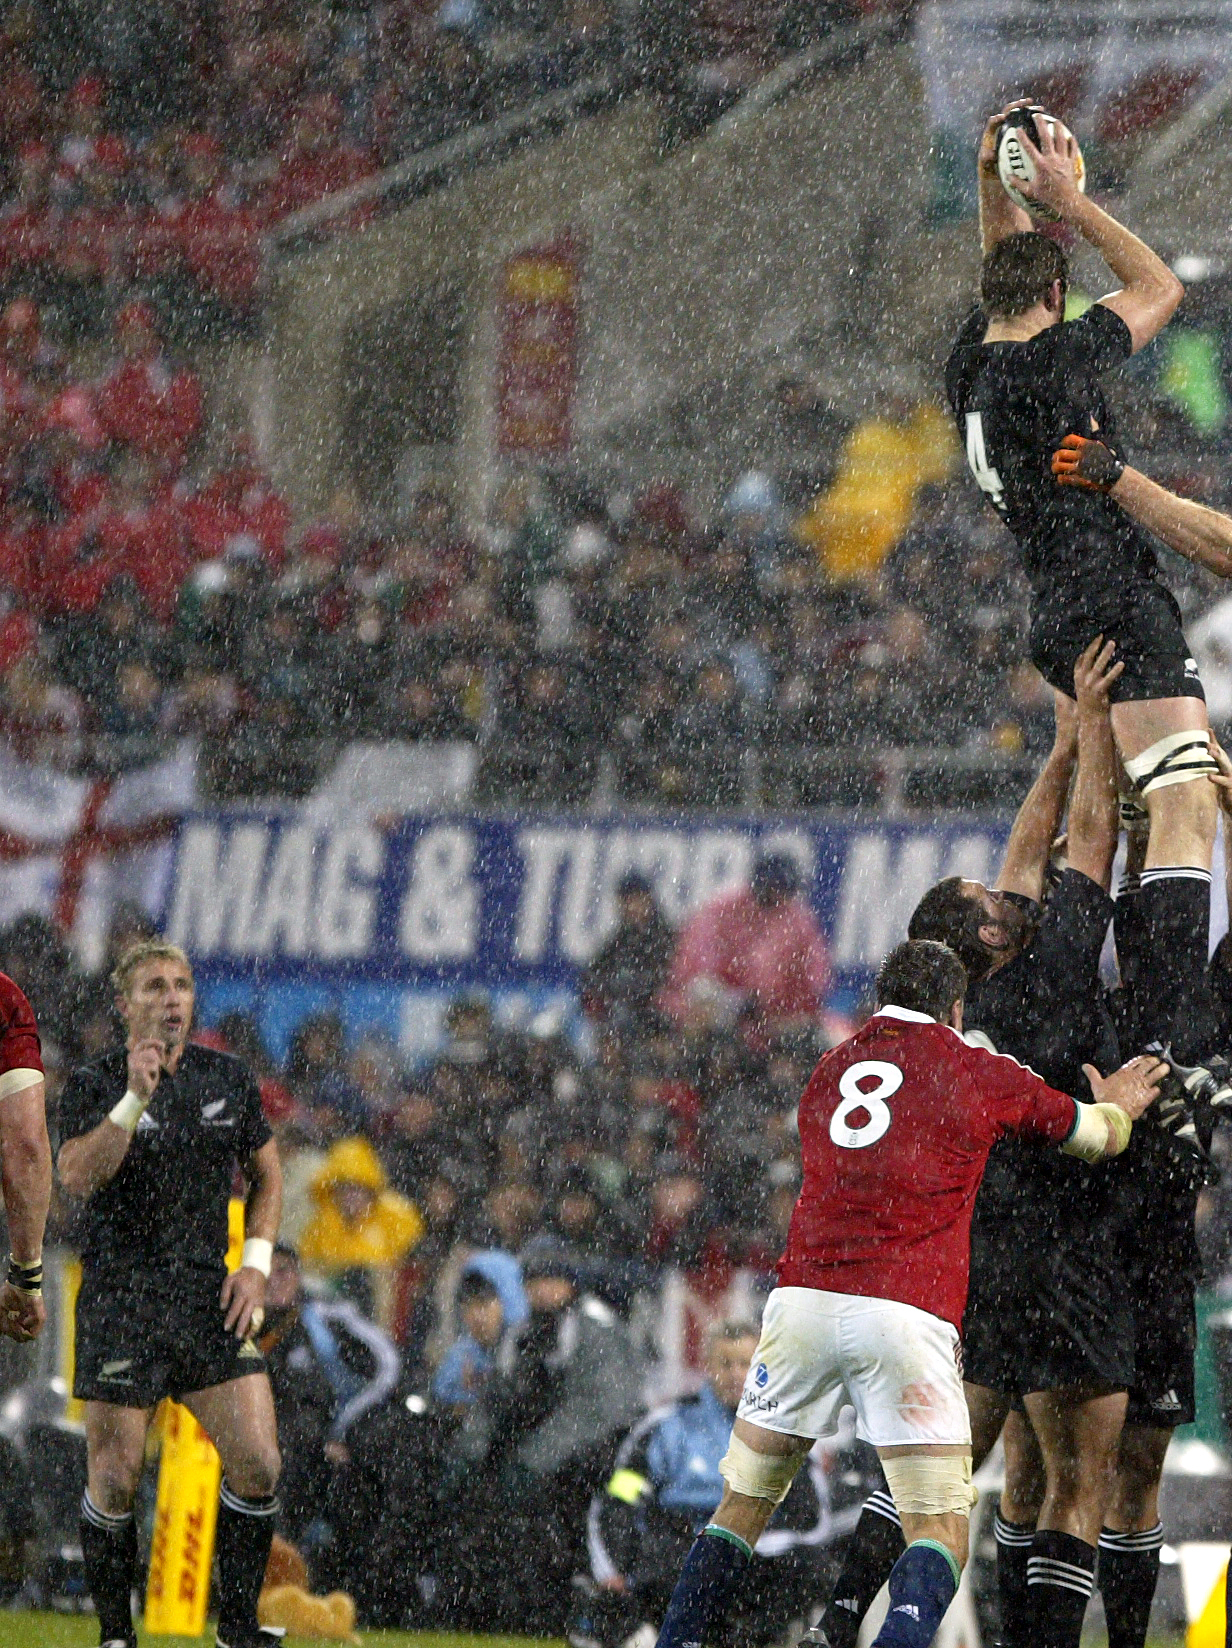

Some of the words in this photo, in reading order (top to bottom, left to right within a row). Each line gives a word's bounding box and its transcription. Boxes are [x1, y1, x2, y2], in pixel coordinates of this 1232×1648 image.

[965, 410, 1008, 511] 4
[169, 823, 384, 958] MAG
[402, 824, 477, 958] &
[830, 1060, 904, 1149] 8
